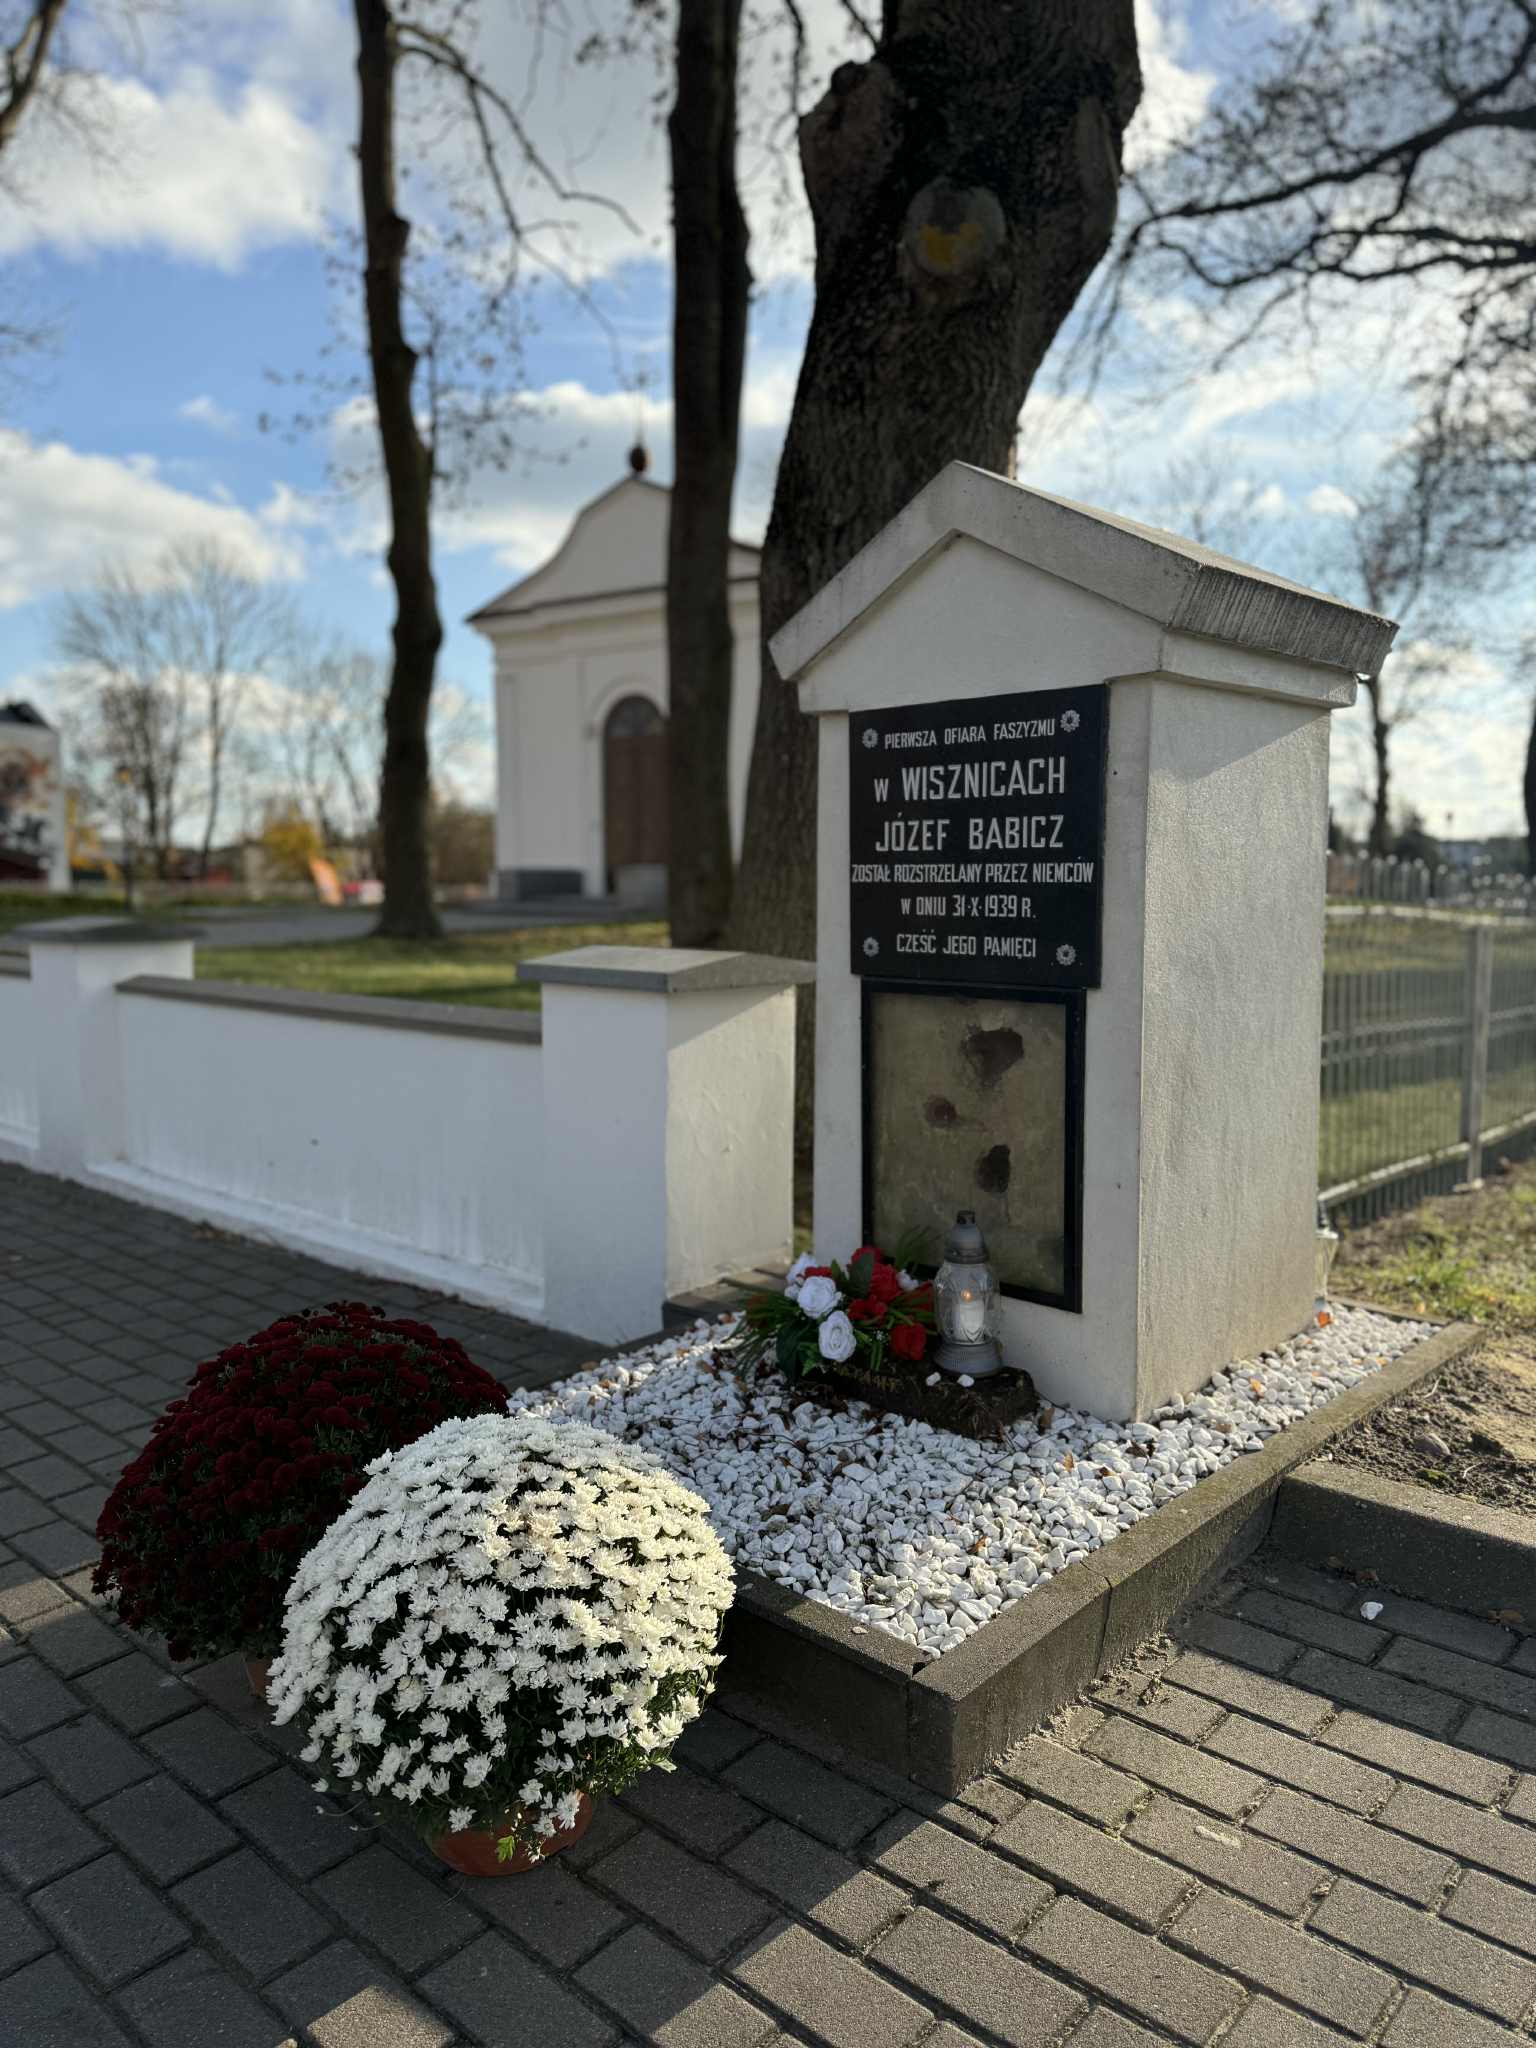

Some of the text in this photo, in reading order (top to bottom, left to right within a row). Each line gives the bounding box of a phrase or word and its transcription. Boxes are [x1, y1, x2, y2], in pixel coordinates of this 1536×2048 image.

[885, 719, 1055, 749] PIERWSZA OFIARA FASZYZMU
[902, 756, 1065, 801] WISZNICACH
[876, 812, 1064, 851] JÓZEF BABICZ
[852, 856, 1094, 883] ZOSTAŁ ROZSTRZELANY PRZEZ NIEMCÓW
[917, 897, 946, 916] DNIU
[896, 928, 1036, 959] CZEŚĆ JEGO PAMIĘCI
